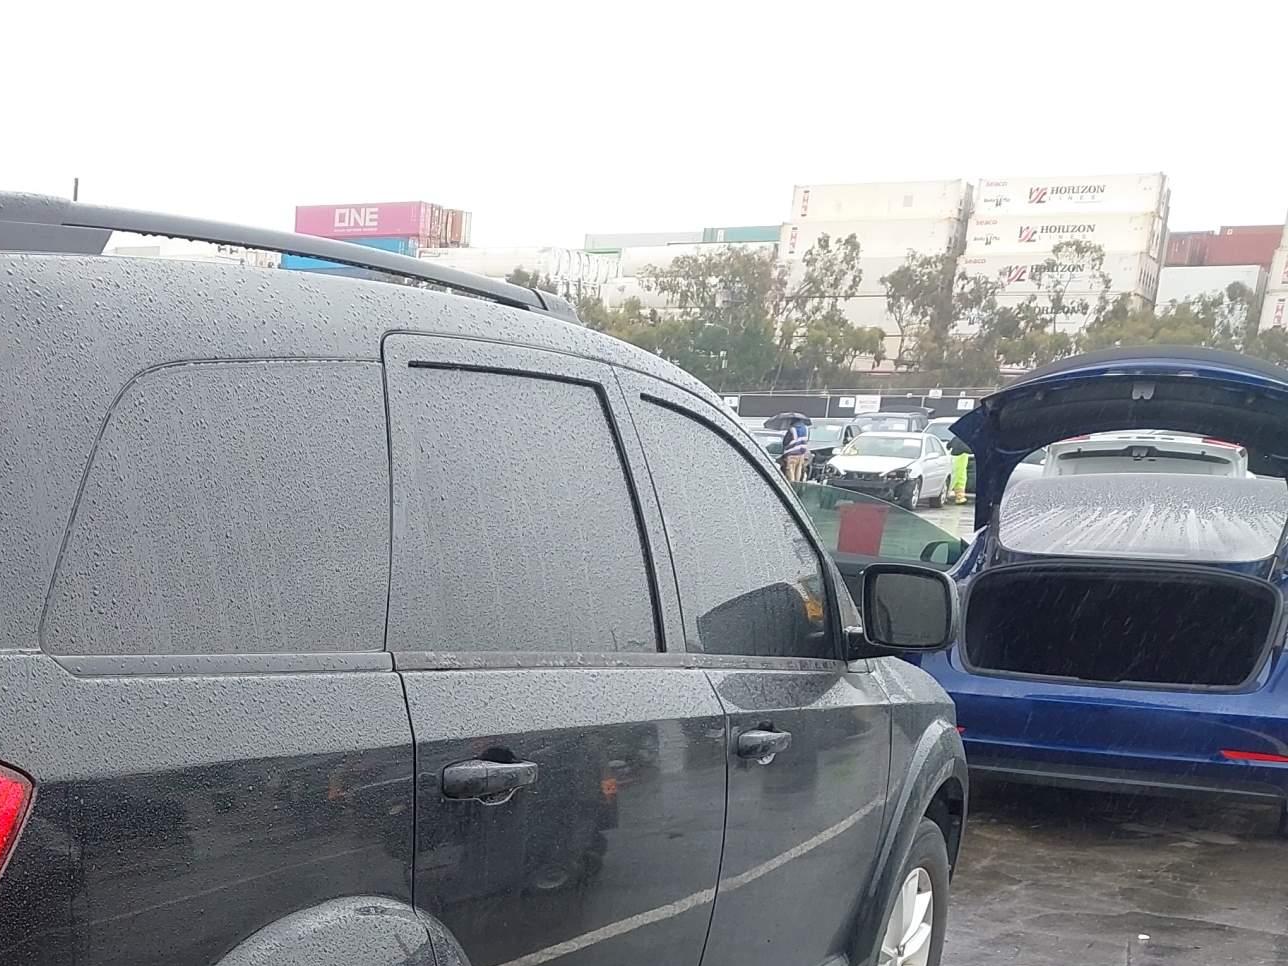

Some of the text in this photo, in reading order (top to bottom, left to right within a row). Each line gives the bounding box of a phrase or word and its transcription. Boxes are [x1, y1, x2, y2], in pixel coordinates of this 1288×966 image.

[1050, 185, 1106, 195] HORIZON
[334, 207, 378, 227] ONE
[1039, 224, 1096, 234] HORIZON
